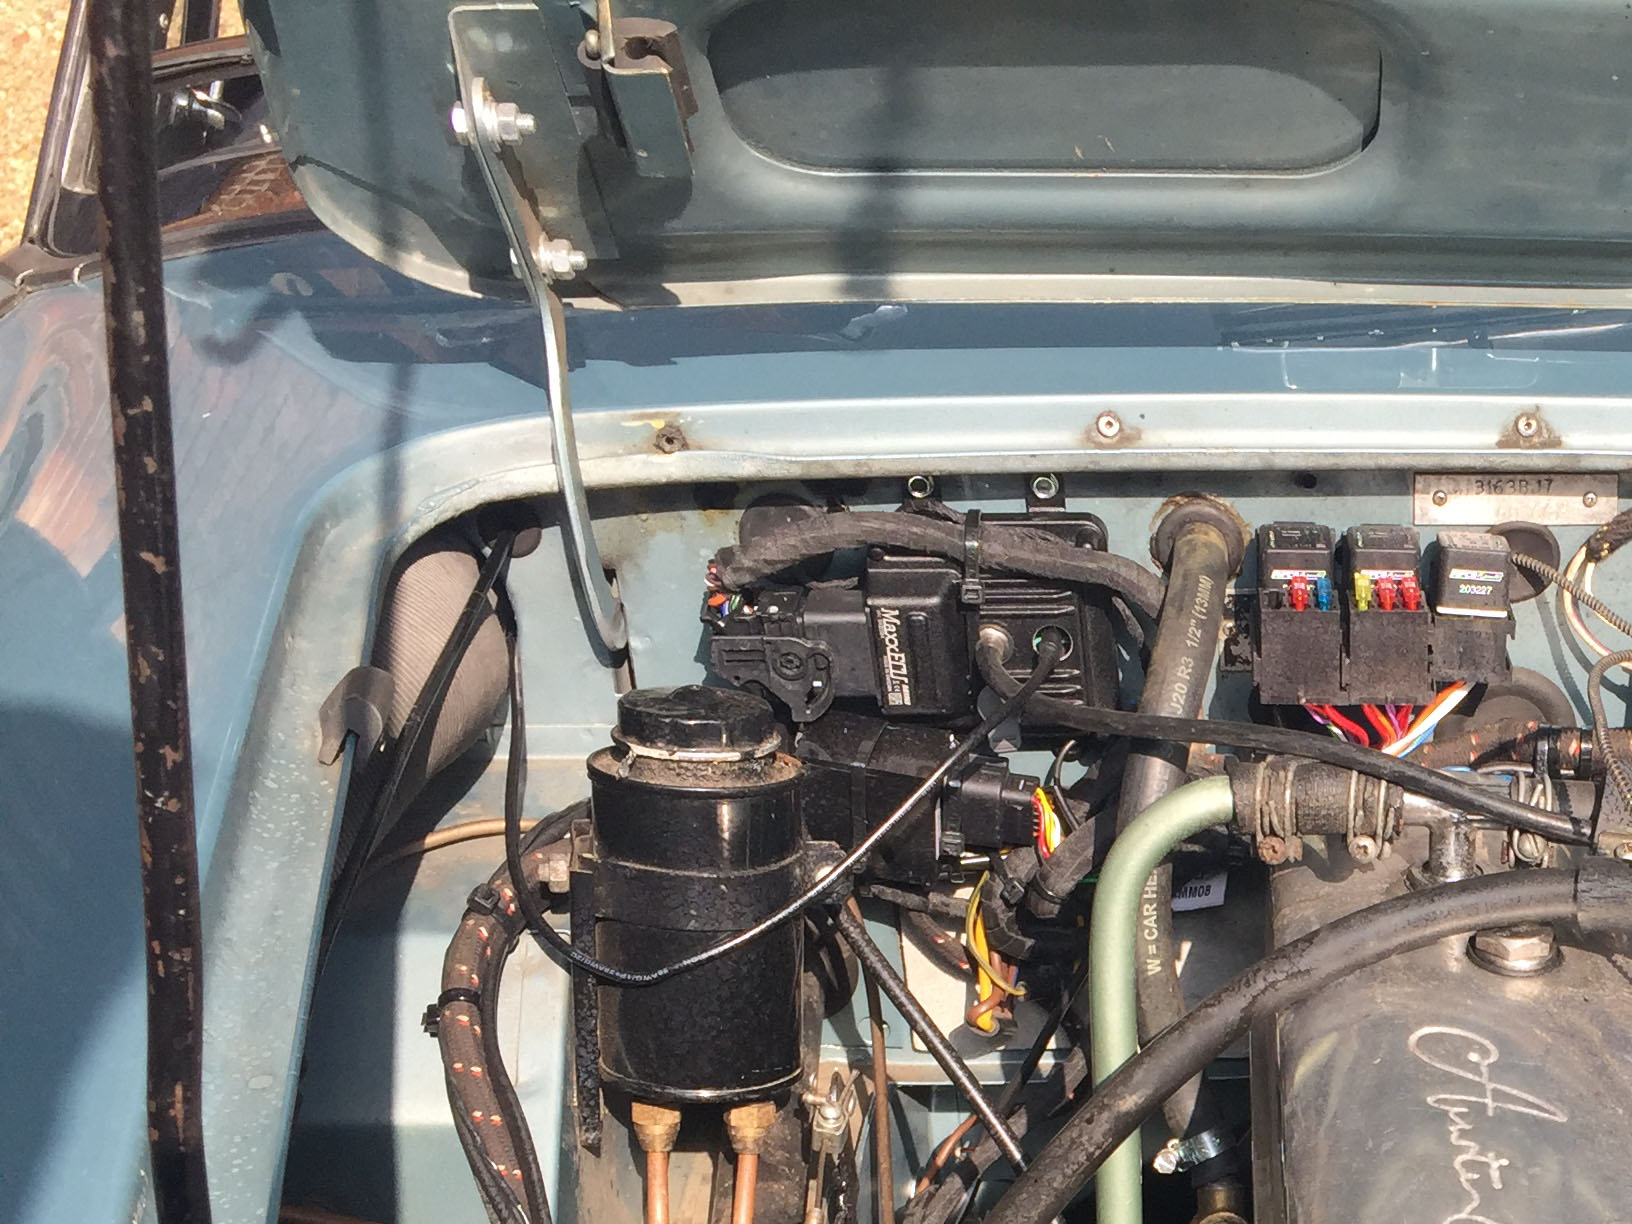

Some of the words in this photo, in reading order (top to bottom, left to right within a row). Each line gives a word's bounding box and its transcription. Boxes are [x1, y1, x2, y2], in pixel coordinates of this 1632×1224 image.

[1459, 584, 1493, 595] 203227
[1176, 656, 1194, 680] R3
[1169, 683, 1188, 716] J20
[1143, 903, 1159, 940] CAR
[1146, 959, 1162, 976] W
